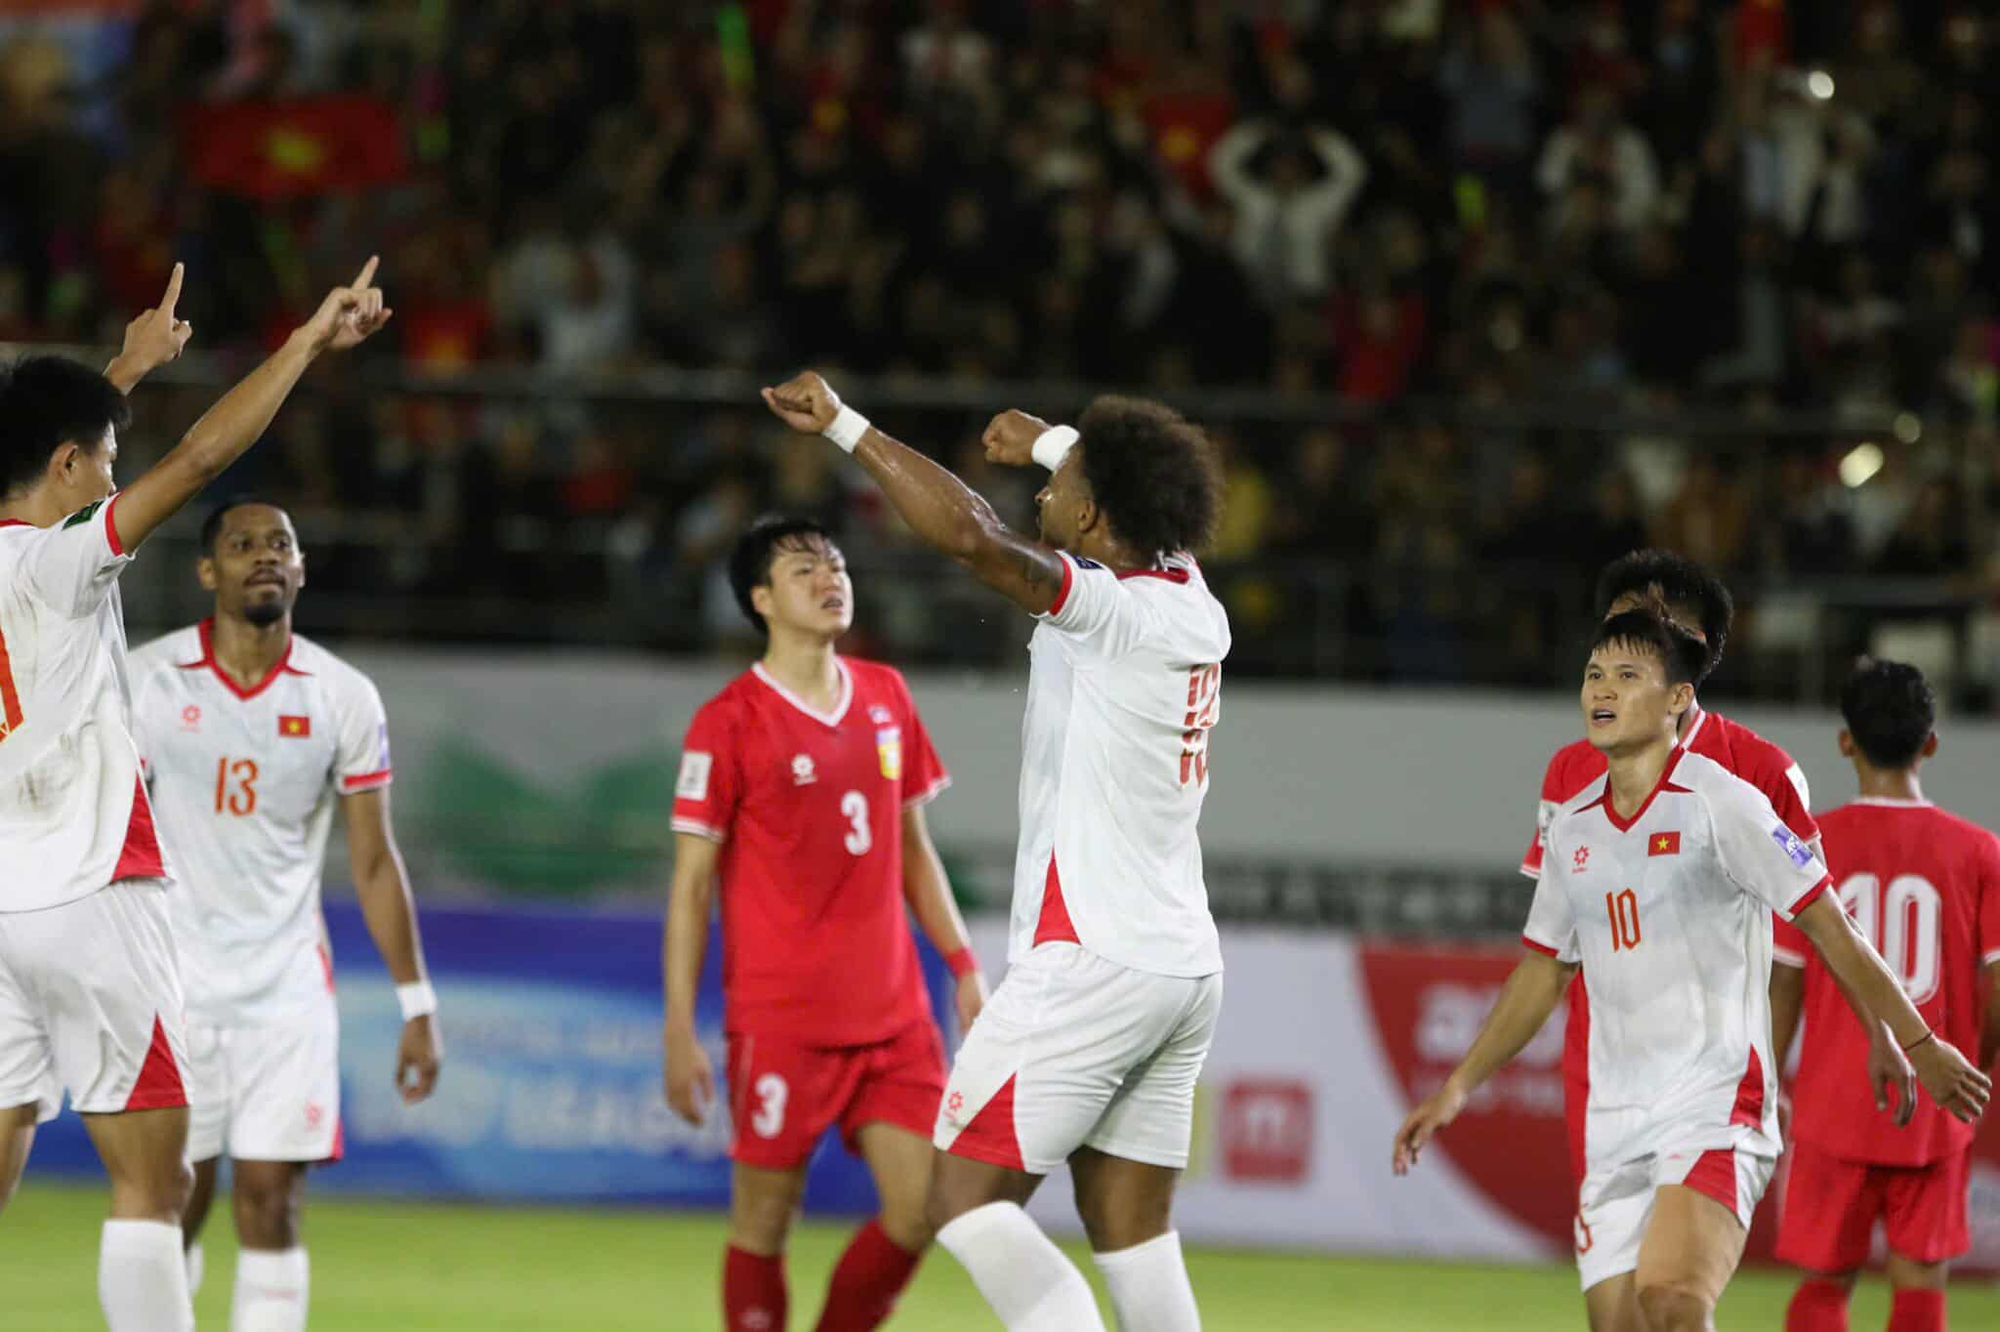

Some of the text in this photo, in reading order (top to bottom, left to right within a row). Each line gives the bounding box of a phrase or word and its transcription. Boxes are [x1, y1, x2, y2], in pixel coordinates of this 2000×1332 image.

[215, 757, 259, 817] 13
[840, 789, 873, 856] 3
[1605, 888, 1642, 952] 10
[1838, 871, 1942, 1006] 10
[751, 1072, 789, 1140] 3
